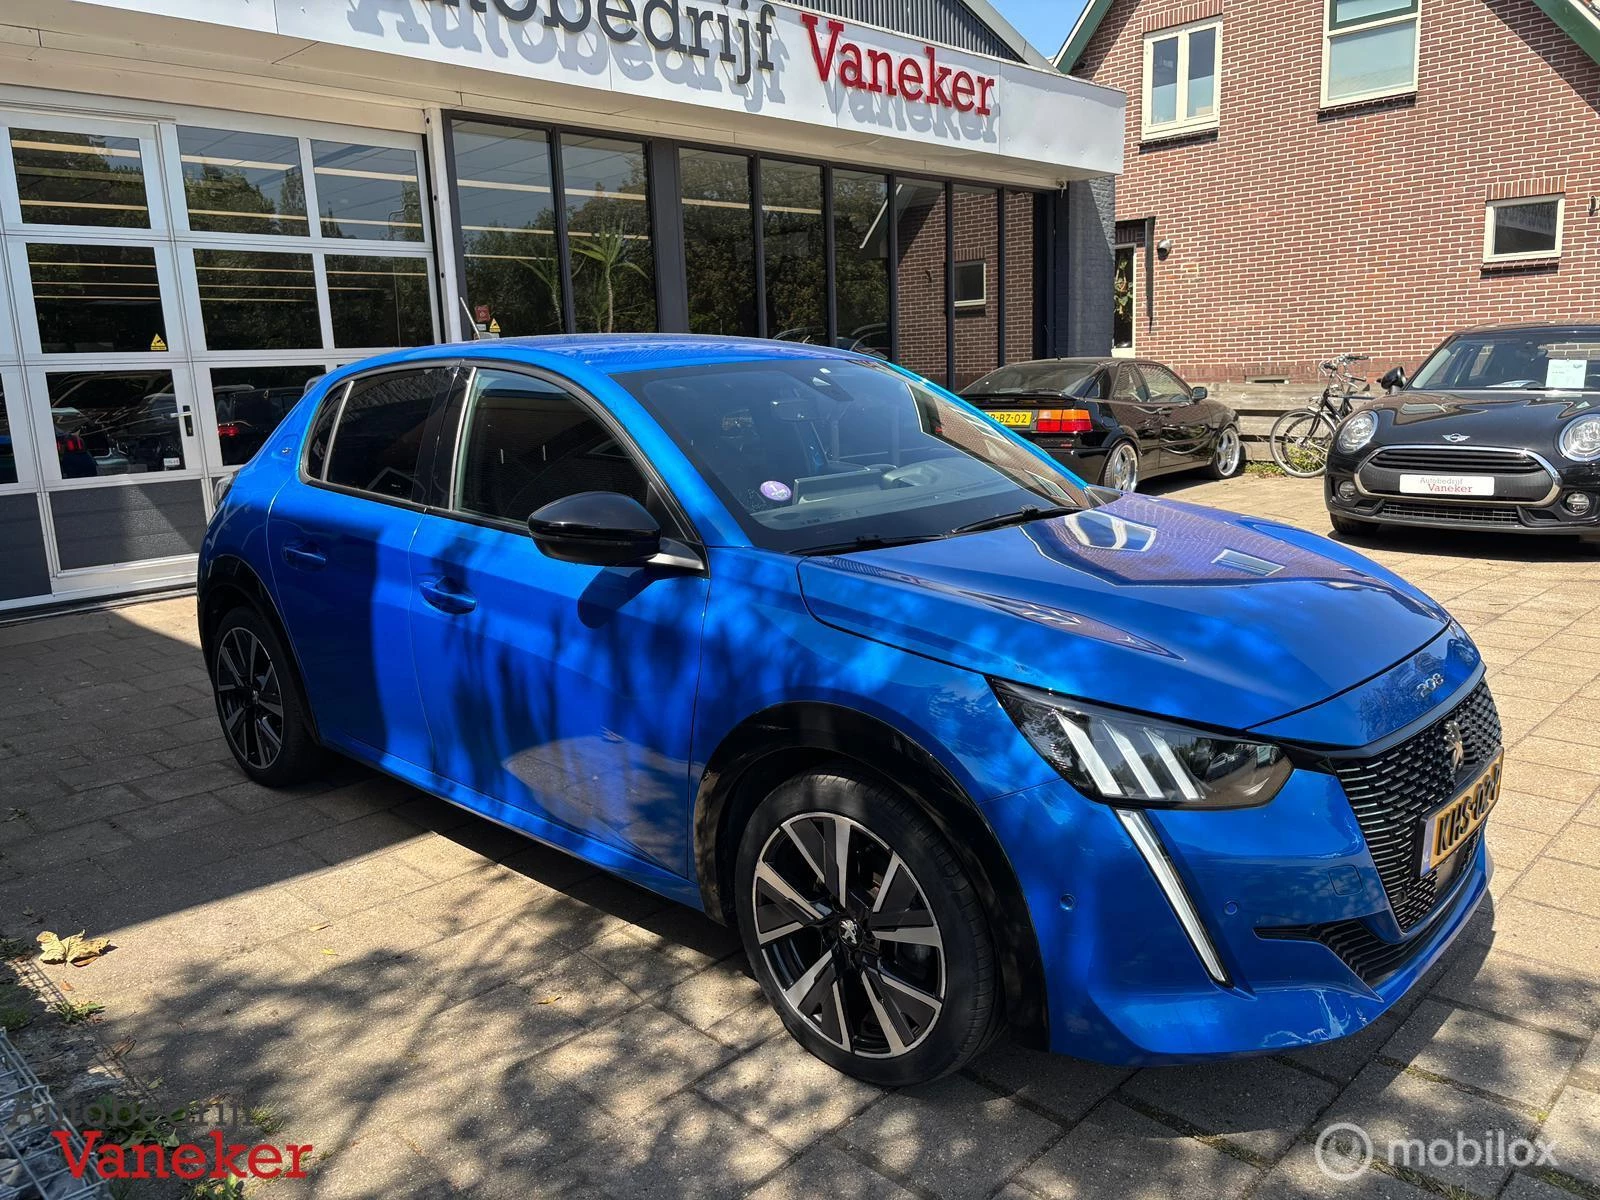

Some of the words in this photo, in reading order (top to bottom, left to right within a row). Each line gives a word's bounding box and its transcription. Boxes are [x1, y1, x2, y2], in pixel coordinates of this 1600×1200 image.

[800, 13, 995, 116] Vaneker
[1428, 483, 1473, 493] Vaneker
[1416, 672, 1444, 698] 208
